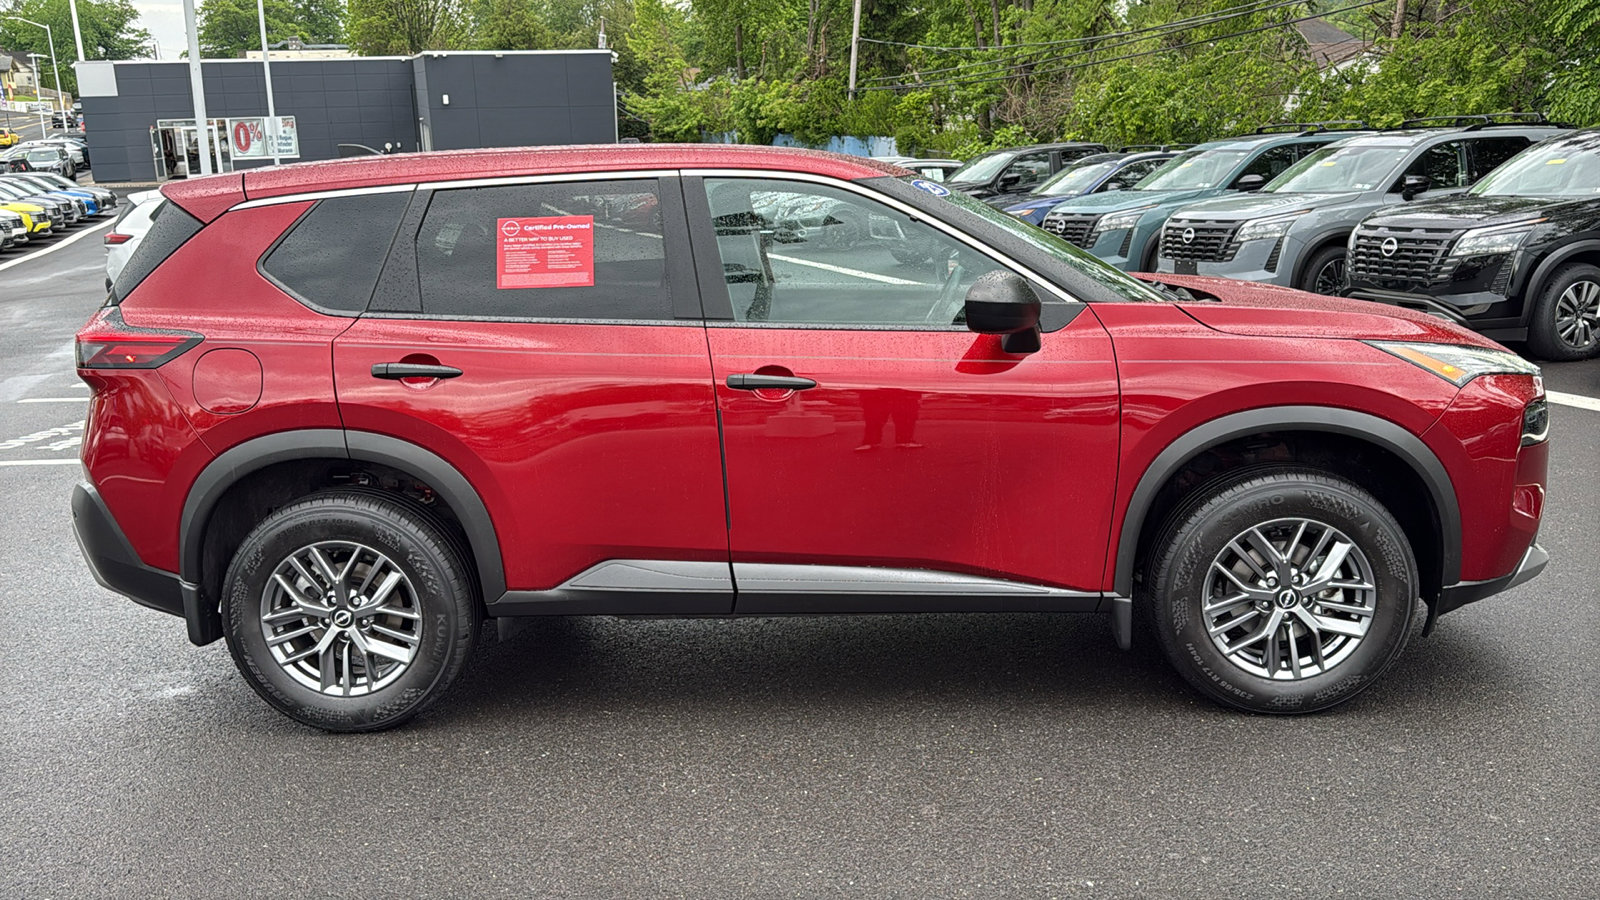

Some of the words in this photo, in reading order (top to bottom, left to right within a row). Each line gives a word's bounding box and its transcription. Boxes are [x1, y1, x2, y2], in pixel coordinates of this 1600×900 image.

[234, 121, 263, 154] 0%
[1185, 642, 1204, 666] 104H
[1202, 667, 1221, 682] R17
